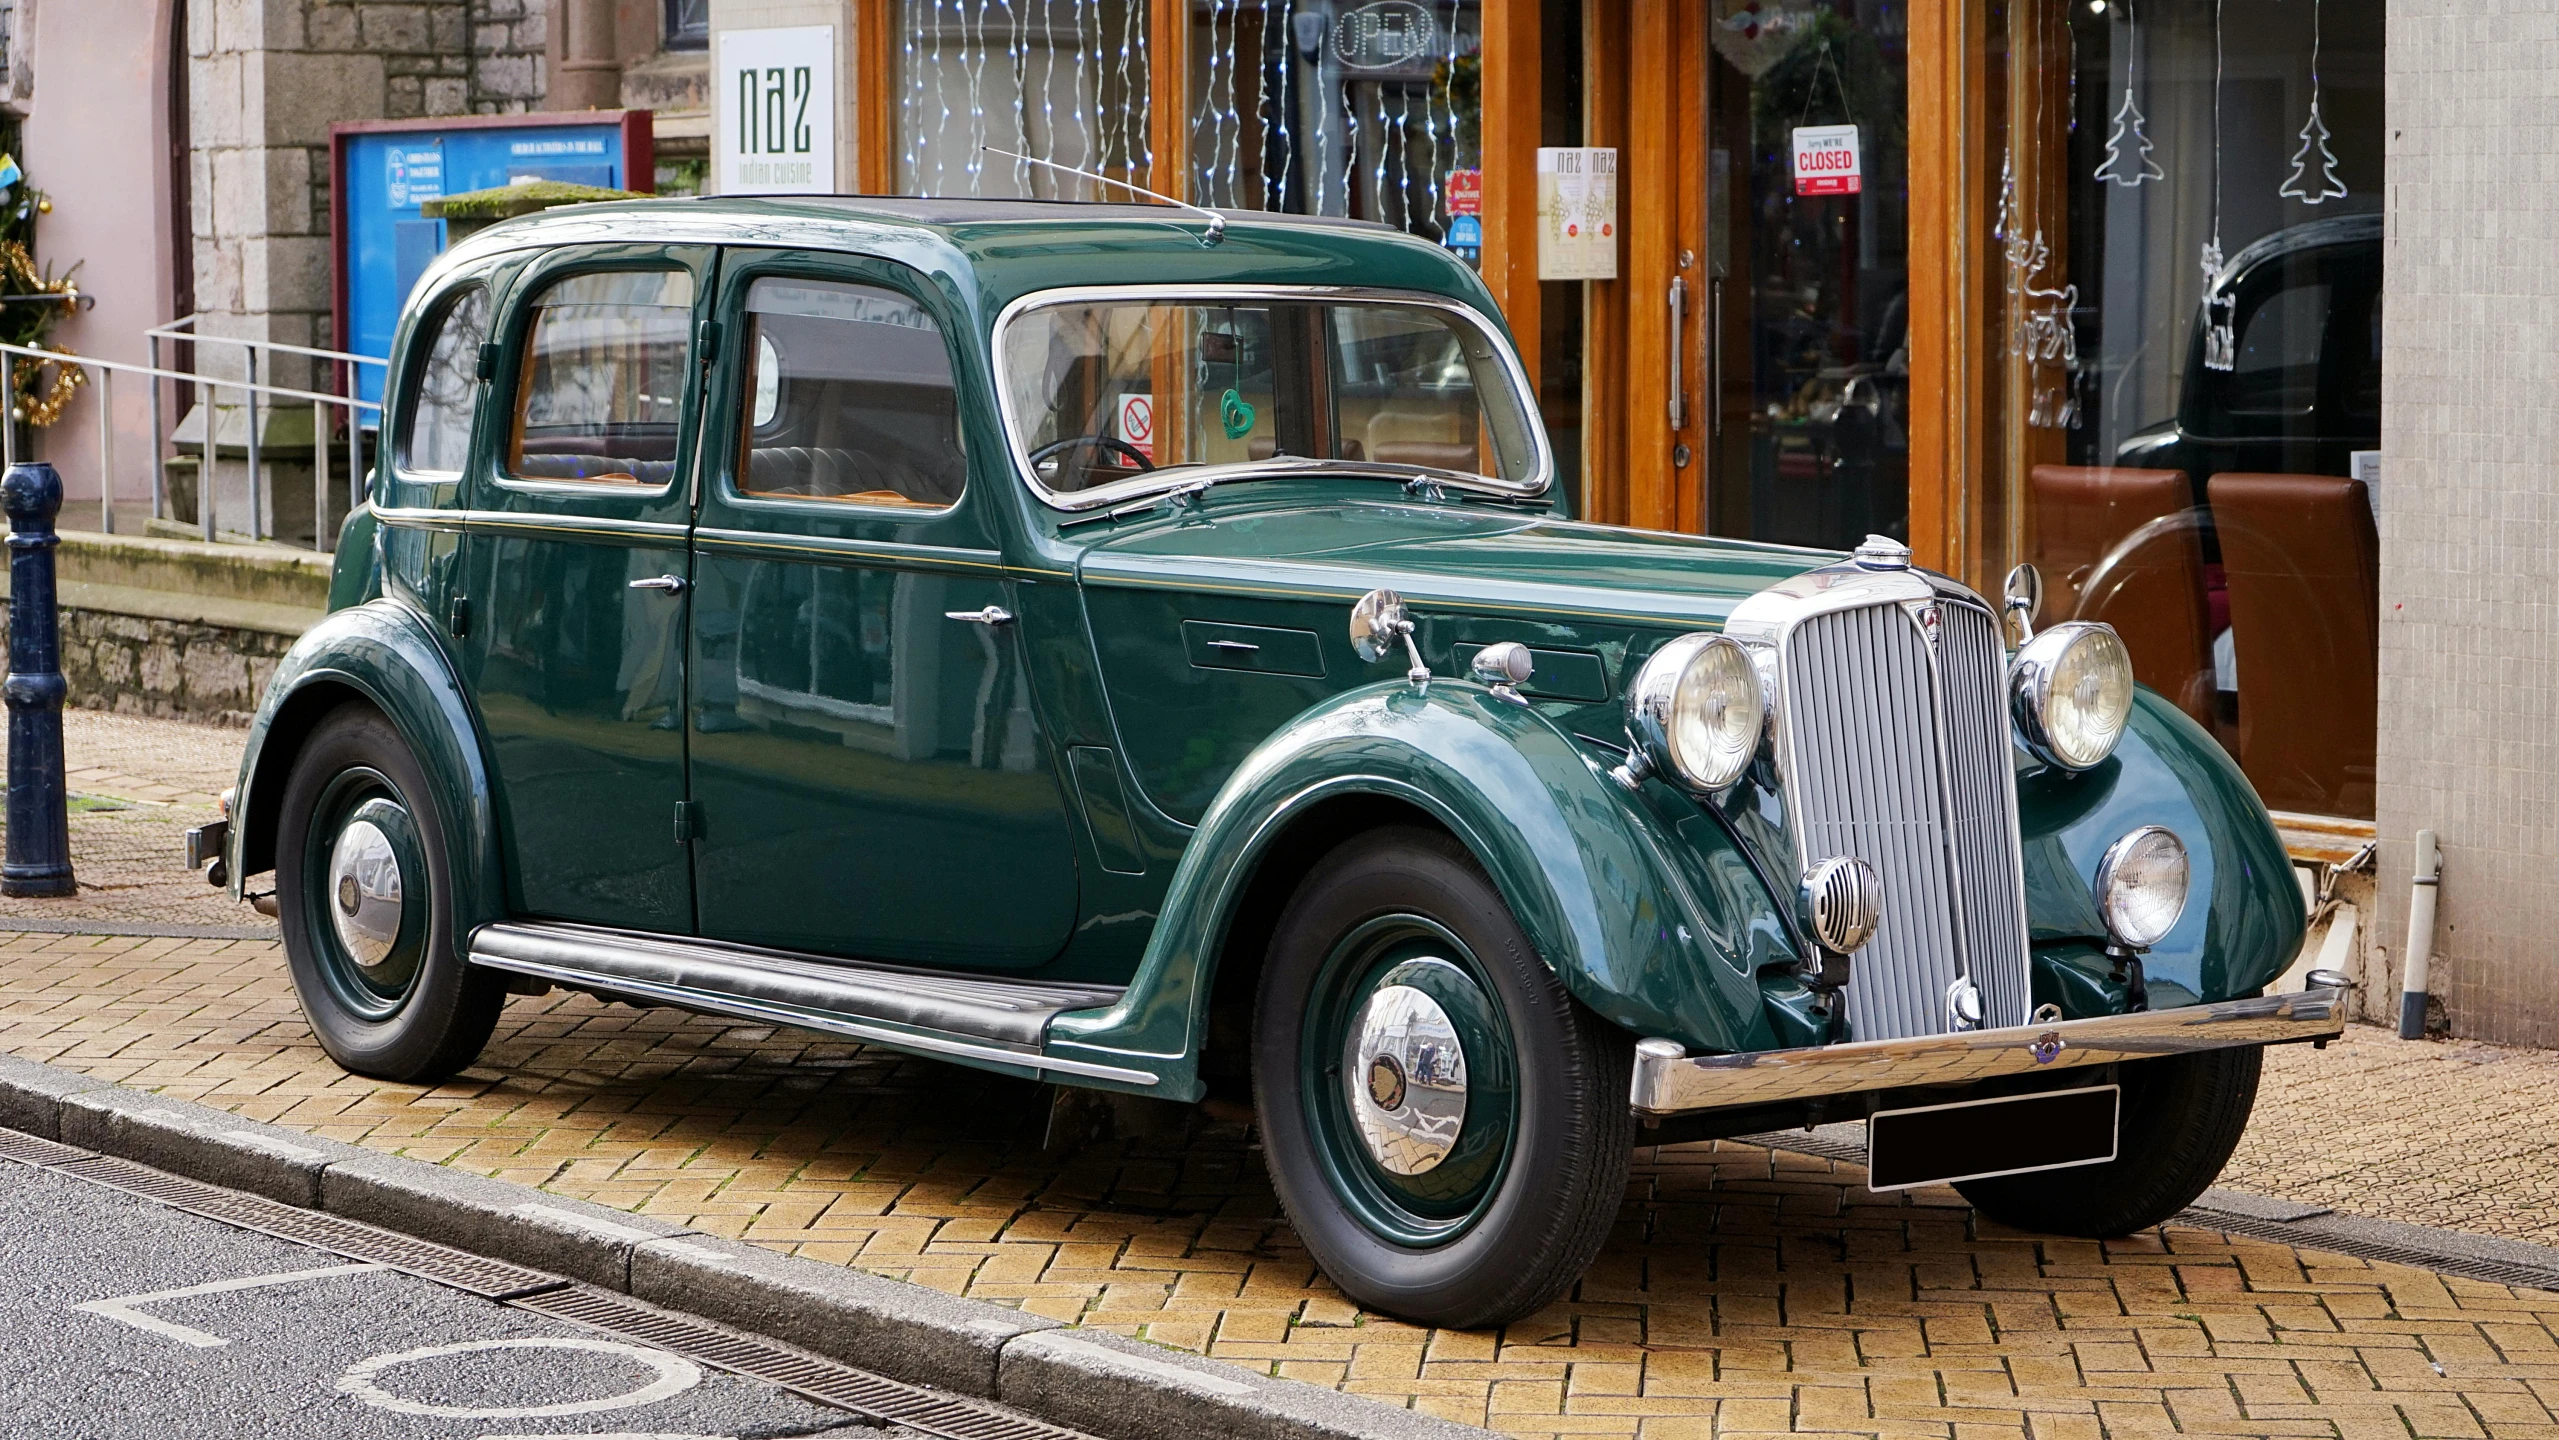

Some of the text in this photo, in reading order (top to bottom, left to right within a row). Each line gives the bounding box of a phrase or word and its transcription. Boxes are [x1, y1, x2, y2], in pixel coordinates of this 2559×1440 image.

[1339, 11, 1425, 57] OPEN
[739, 66, 811, 154] naz
[1822, 137, 1843, 147] WE'RE
[1799, 150, 1852, 172] CLOSED
